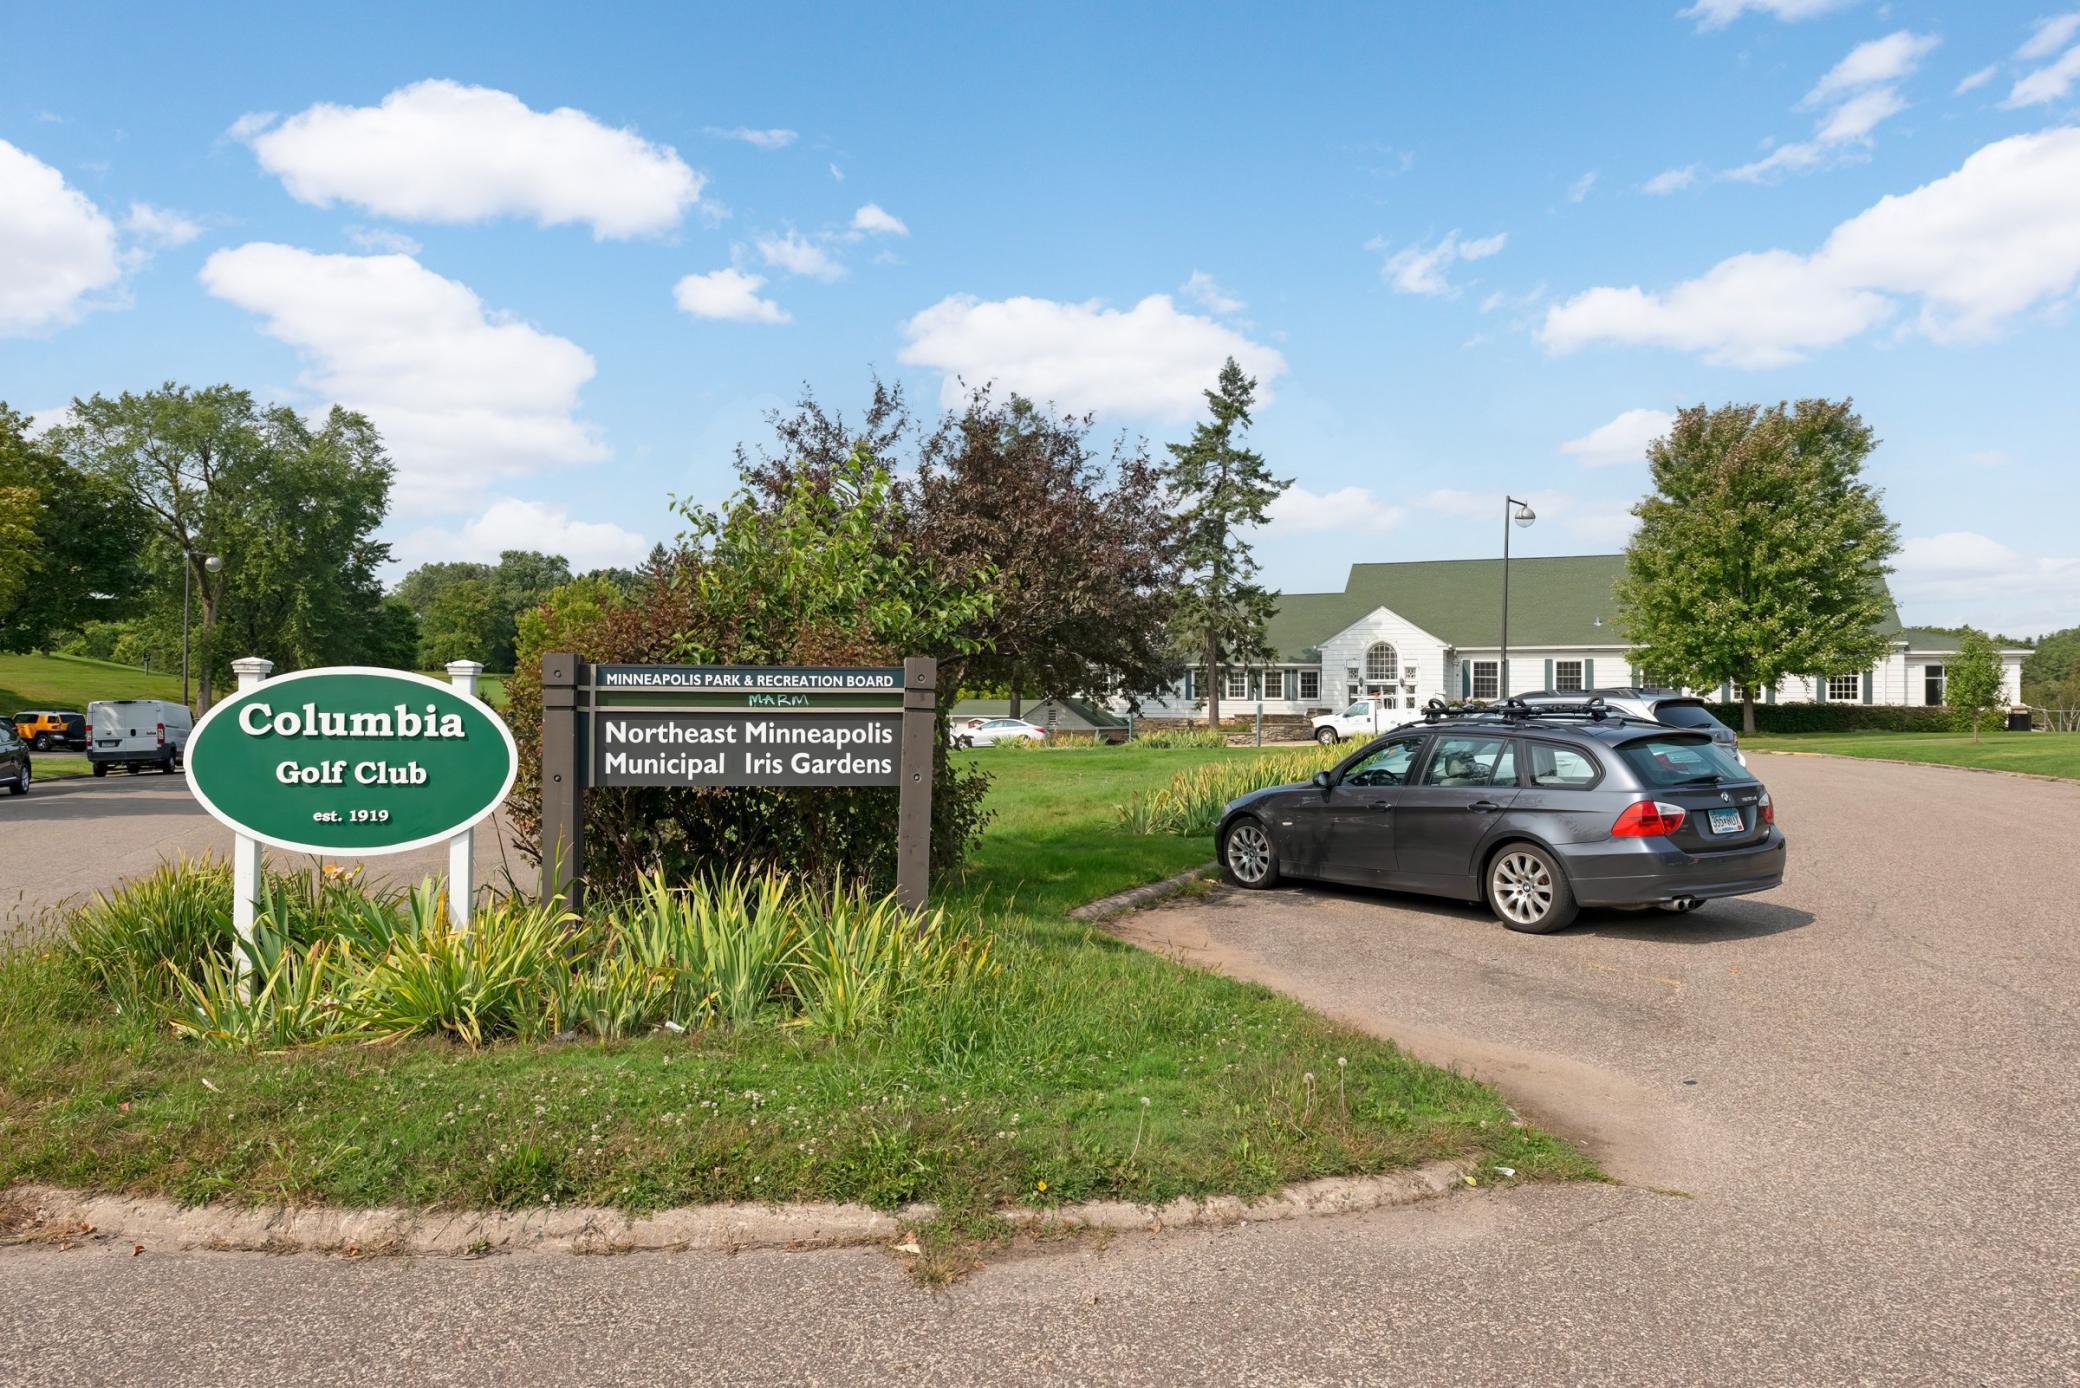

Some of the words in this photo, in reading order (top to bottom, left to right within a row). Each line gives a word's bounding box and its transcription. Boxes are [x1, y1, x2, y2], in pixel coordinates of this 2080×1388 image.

[606, 673, 702, 687] MINNEAPOLIS
[704, 674, 740, 687] PARK
[743, 675, 753, 687] &
[756, 675, 844, 688] RECREATION
[846, 675, 894, 688] BOARD
[238, 703, 465, 738] Columbia
[605, 721, 737, 744] Northeast
[745, 722, 893, 750] Minneapolis
[276, 760, 347, 784] Golf
[355, 761, 427, 785] Club
[605, 752, 725, 780] Municipal
[745, 753, 783, 775] Iris
[790, 753, 892, 775] Gardens
[313, 811, 342, 822] est.
[350, 810, 389, 822] 1919
